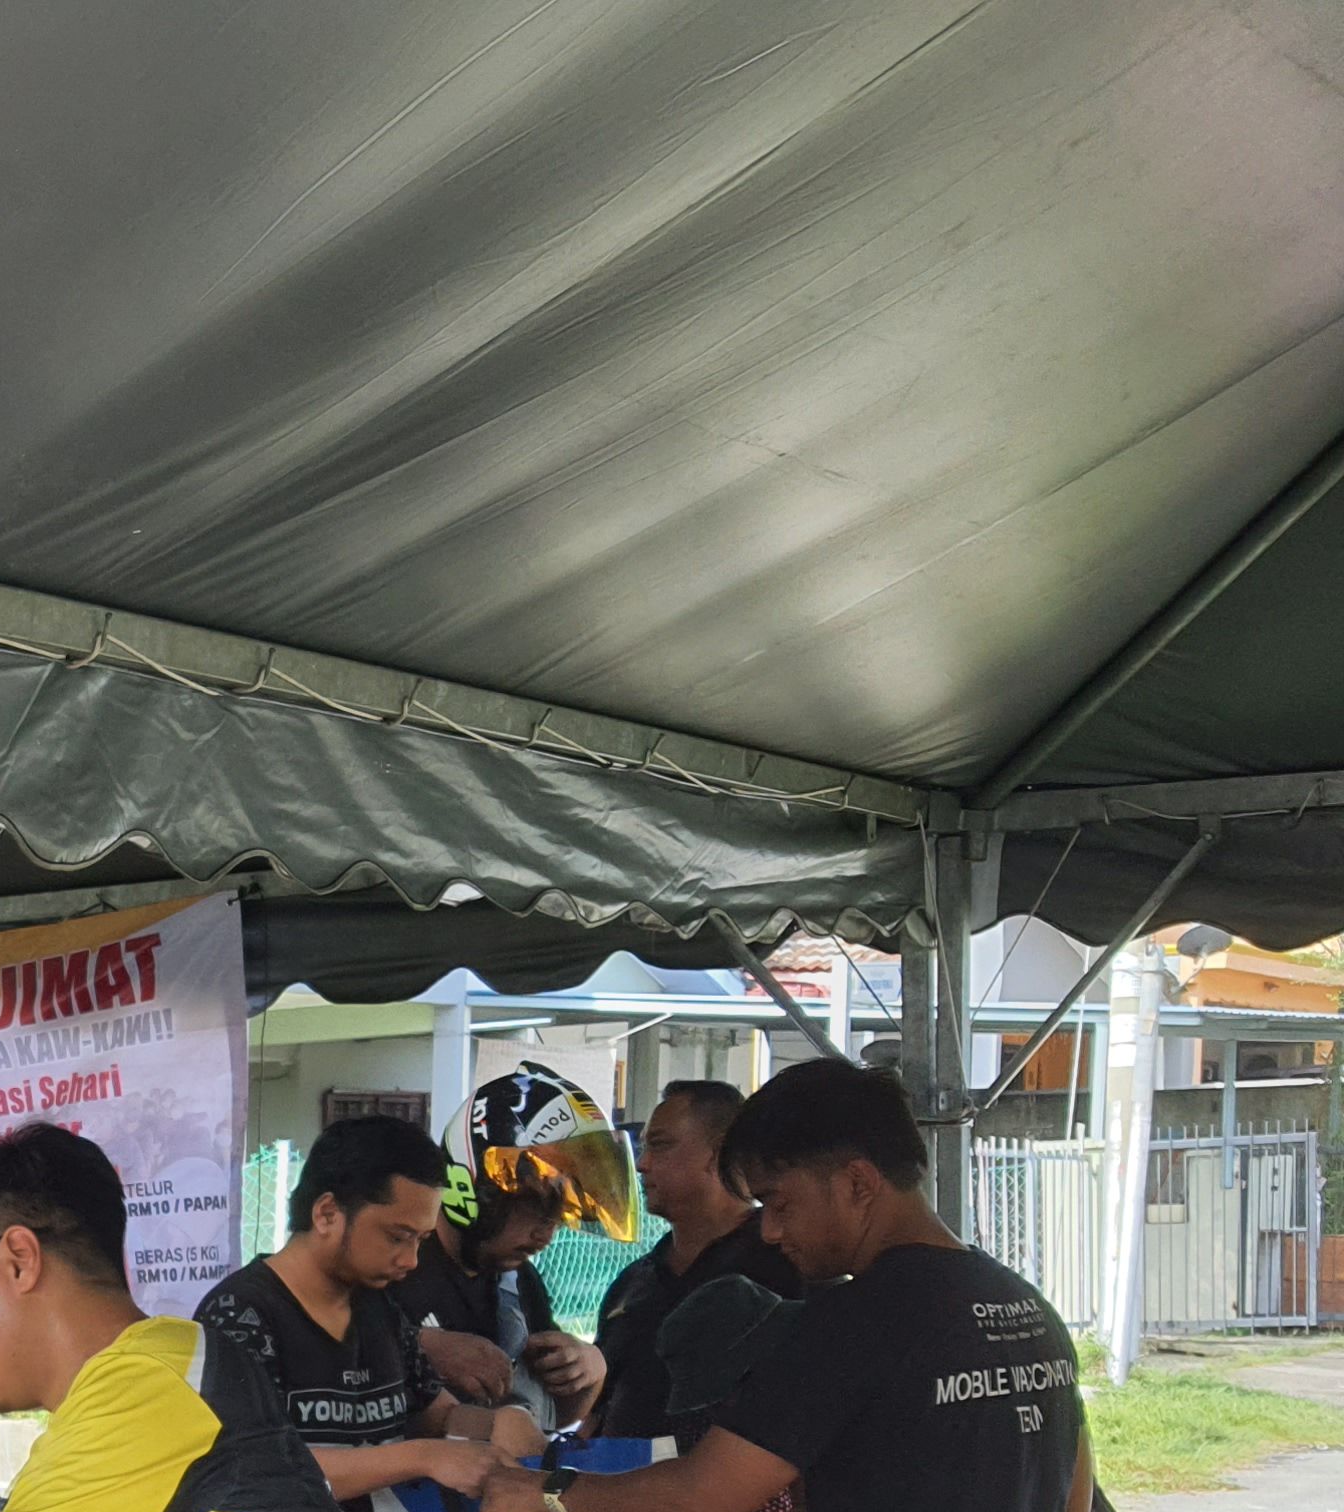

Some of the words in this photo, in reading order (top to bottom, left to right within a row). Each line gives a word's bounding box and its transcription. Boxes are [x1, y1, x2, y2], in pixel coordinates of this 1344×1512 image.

[17, 1008, 174, 1066] KAW-KAW!!
[41, 1064, 123, 1108] Sehari
[126, 1180, 174, 1198] TELUR
[128, 1200, 171, 1217] RM10
[174, 1199, 180, 1213] /
[184, 1195, 227, 1213] PAPAN
[135, 1247, 183, 1265] BERAS
[186, 1247, 198, 1263] (5
[201, 1246, 219, 1261] KG)
[137, 1268, 178, 1284] RM10
[180, 1267, 186, 1281] /
[972, 1298, 1042, 1318] OPTIMAX
[297, 1399, 352, 1423] YOUR
